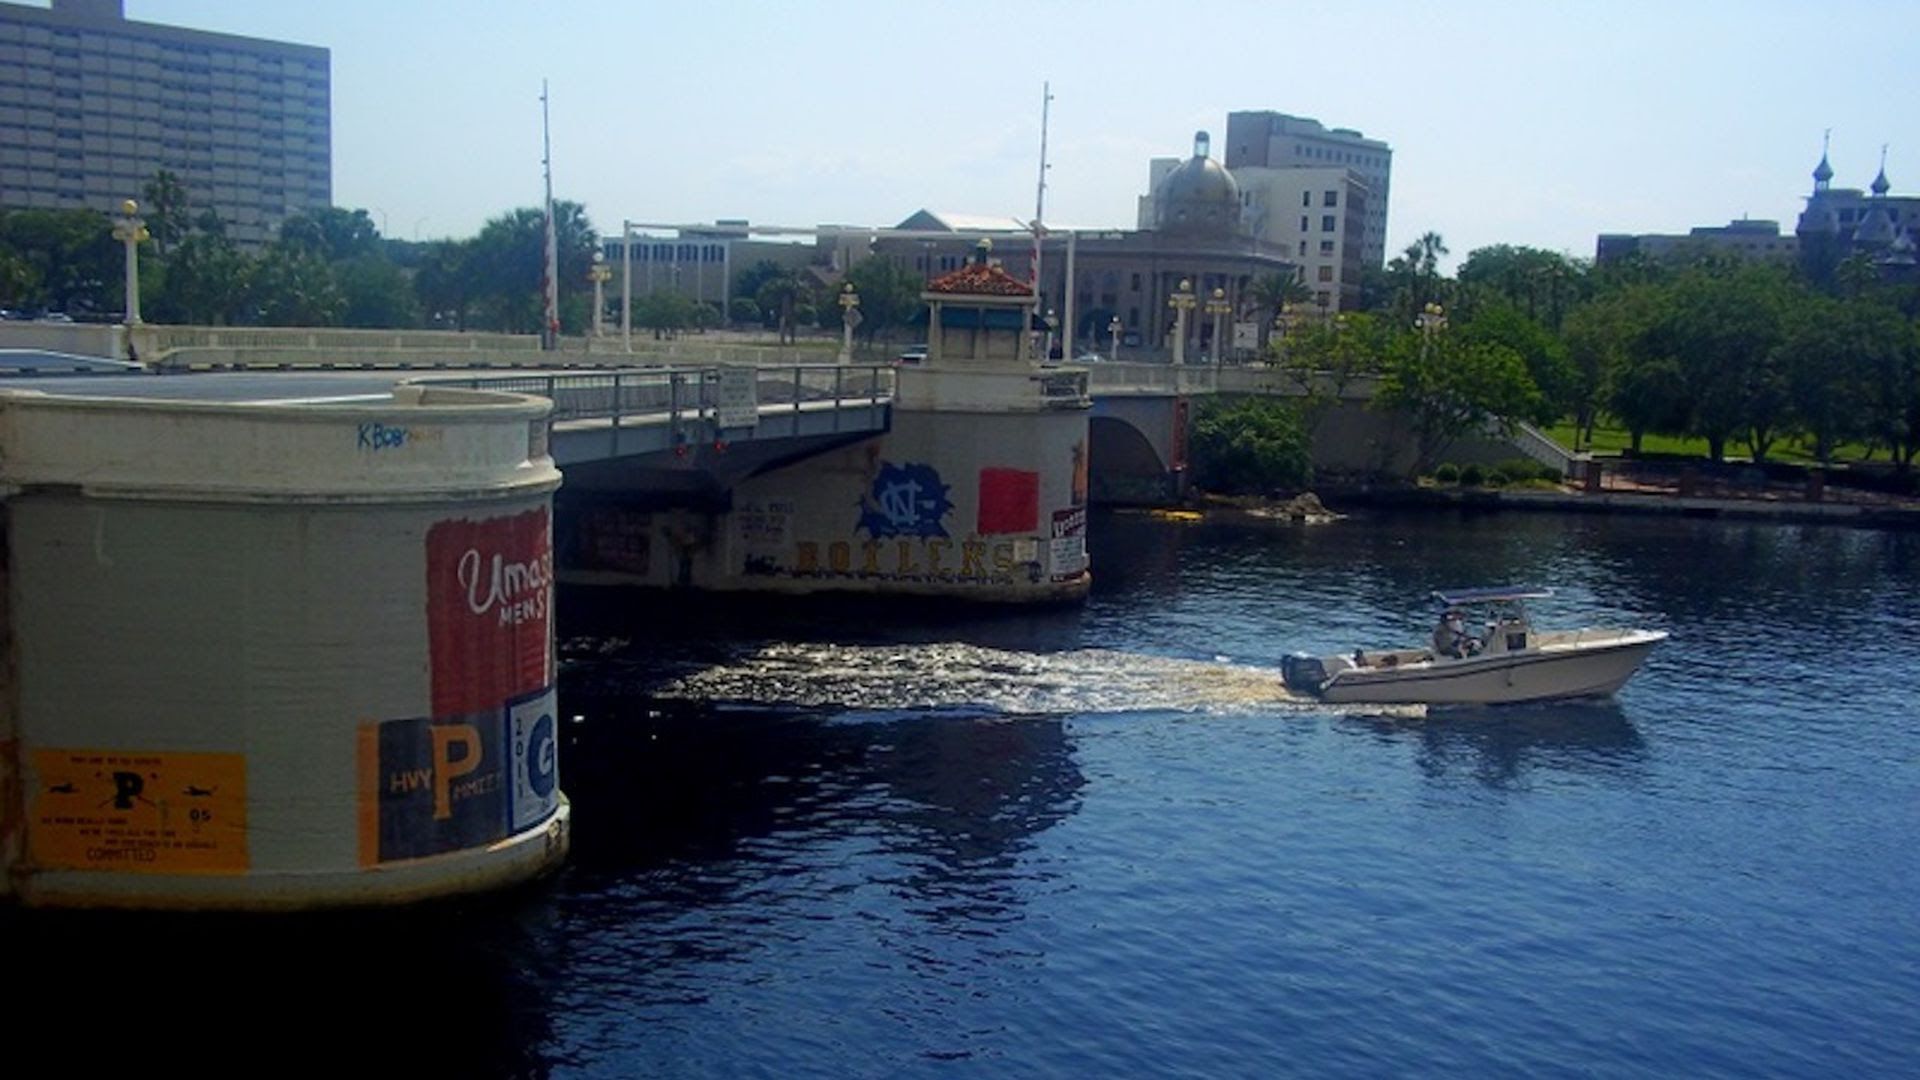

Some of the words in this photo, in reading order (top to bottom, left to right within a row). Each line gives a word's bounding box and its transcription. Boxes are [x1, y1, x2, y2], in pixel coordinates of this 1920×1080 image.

[113, 771, 145, 810] P
[429, 722, 484, 821] P
[86, 848, 157, 863] COMMITTED
